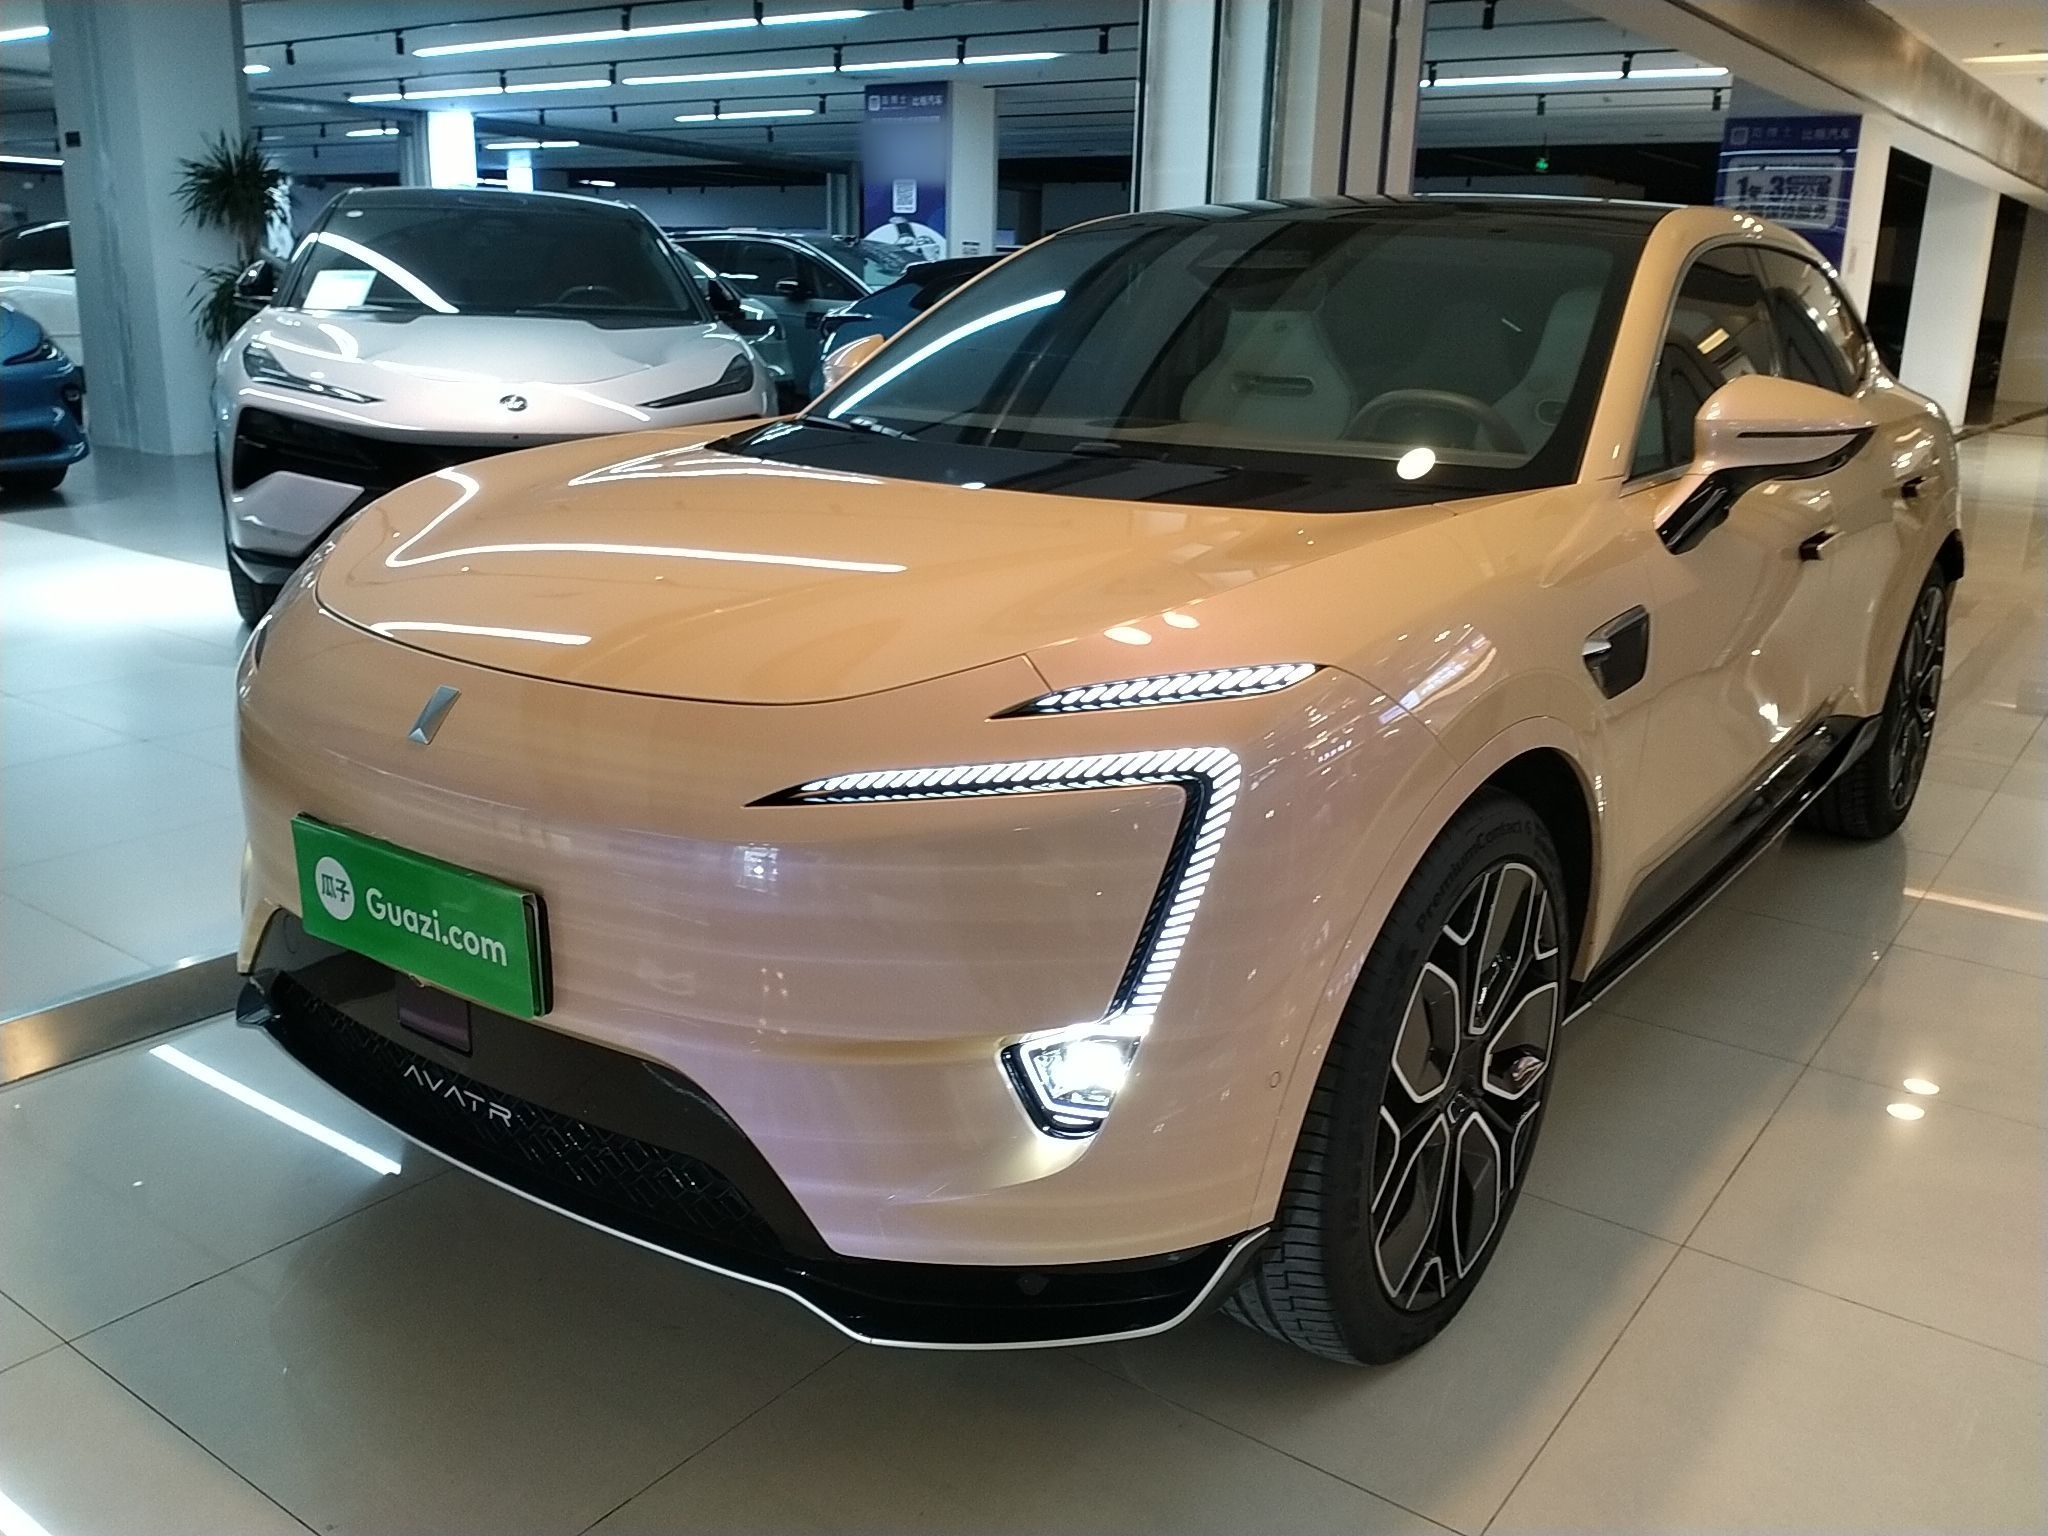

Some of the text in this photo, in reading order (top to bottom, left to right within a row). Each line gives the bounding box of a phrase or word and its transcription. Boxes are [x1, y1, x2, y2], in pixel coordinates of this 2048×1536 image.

[321, 873, 350, 902] 瓜子
[366, 887, 508, 966] Guazi.com
[403, 1065, 512, 1127] AVATR
